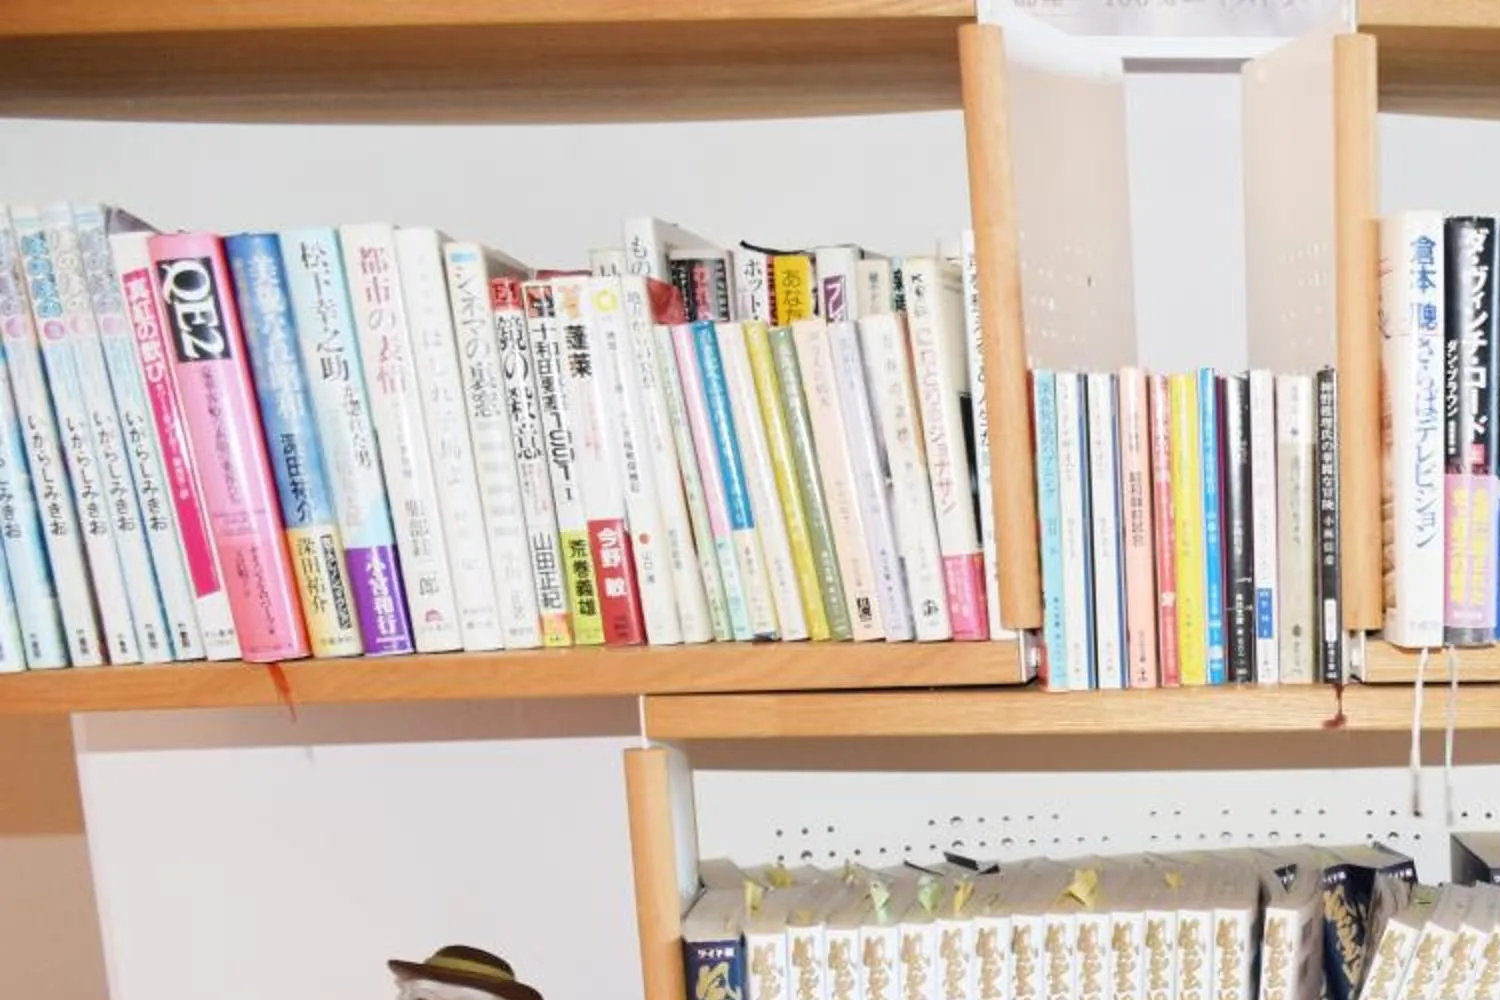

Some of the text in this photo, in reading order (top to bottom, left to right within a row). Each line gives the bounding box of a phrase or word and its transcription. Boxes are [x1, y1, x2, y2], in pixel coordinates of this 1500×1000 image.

[162, 261, 227, 360] QE2
[563, 324, 593, 378] 蓬莱
[1464, 227, 1490, 437] ダ・ヴィンチ・コード
